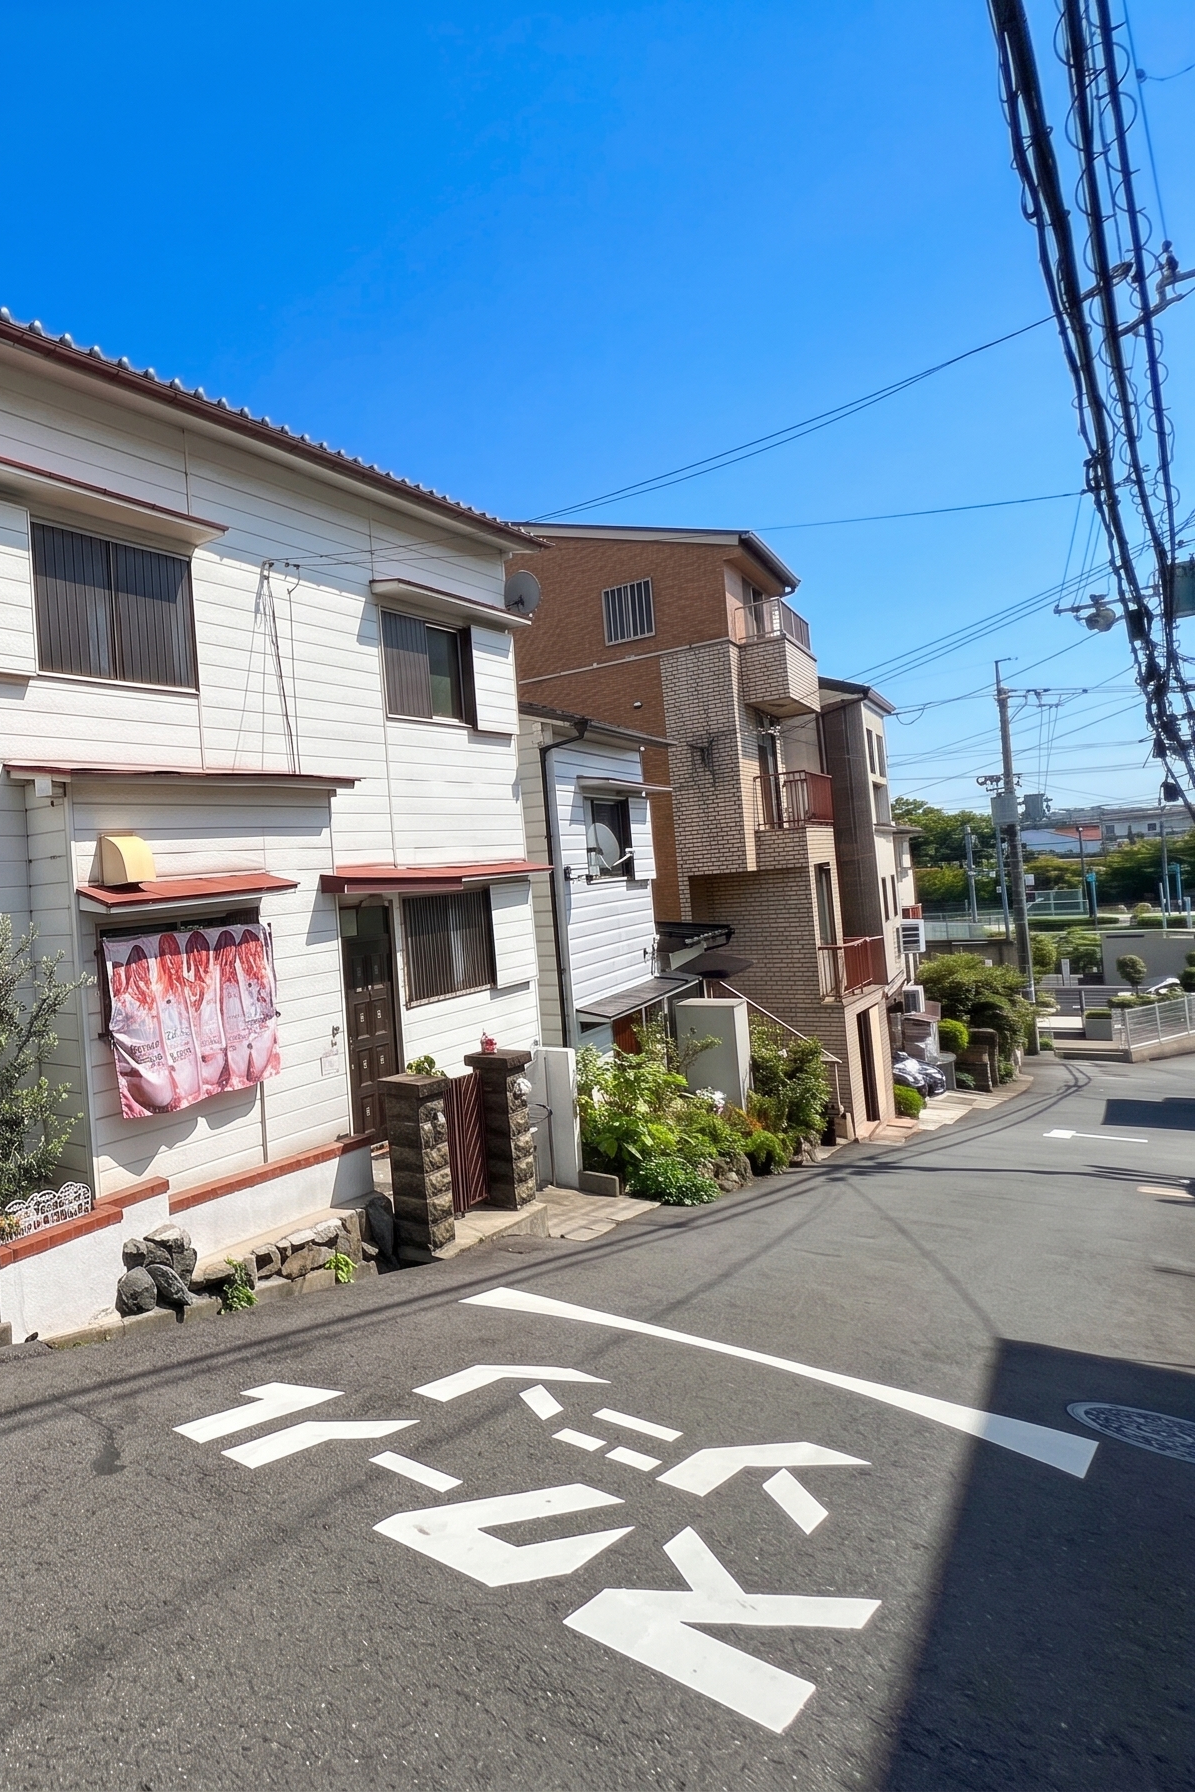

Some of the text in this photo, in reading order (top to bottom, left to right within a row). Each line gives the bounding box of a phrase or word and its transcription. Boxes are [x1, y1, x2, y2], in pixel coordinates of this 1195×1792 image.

[173, 1382, 882, 1733] スクール
[412, 1364, 872, 1535] ゾーン
